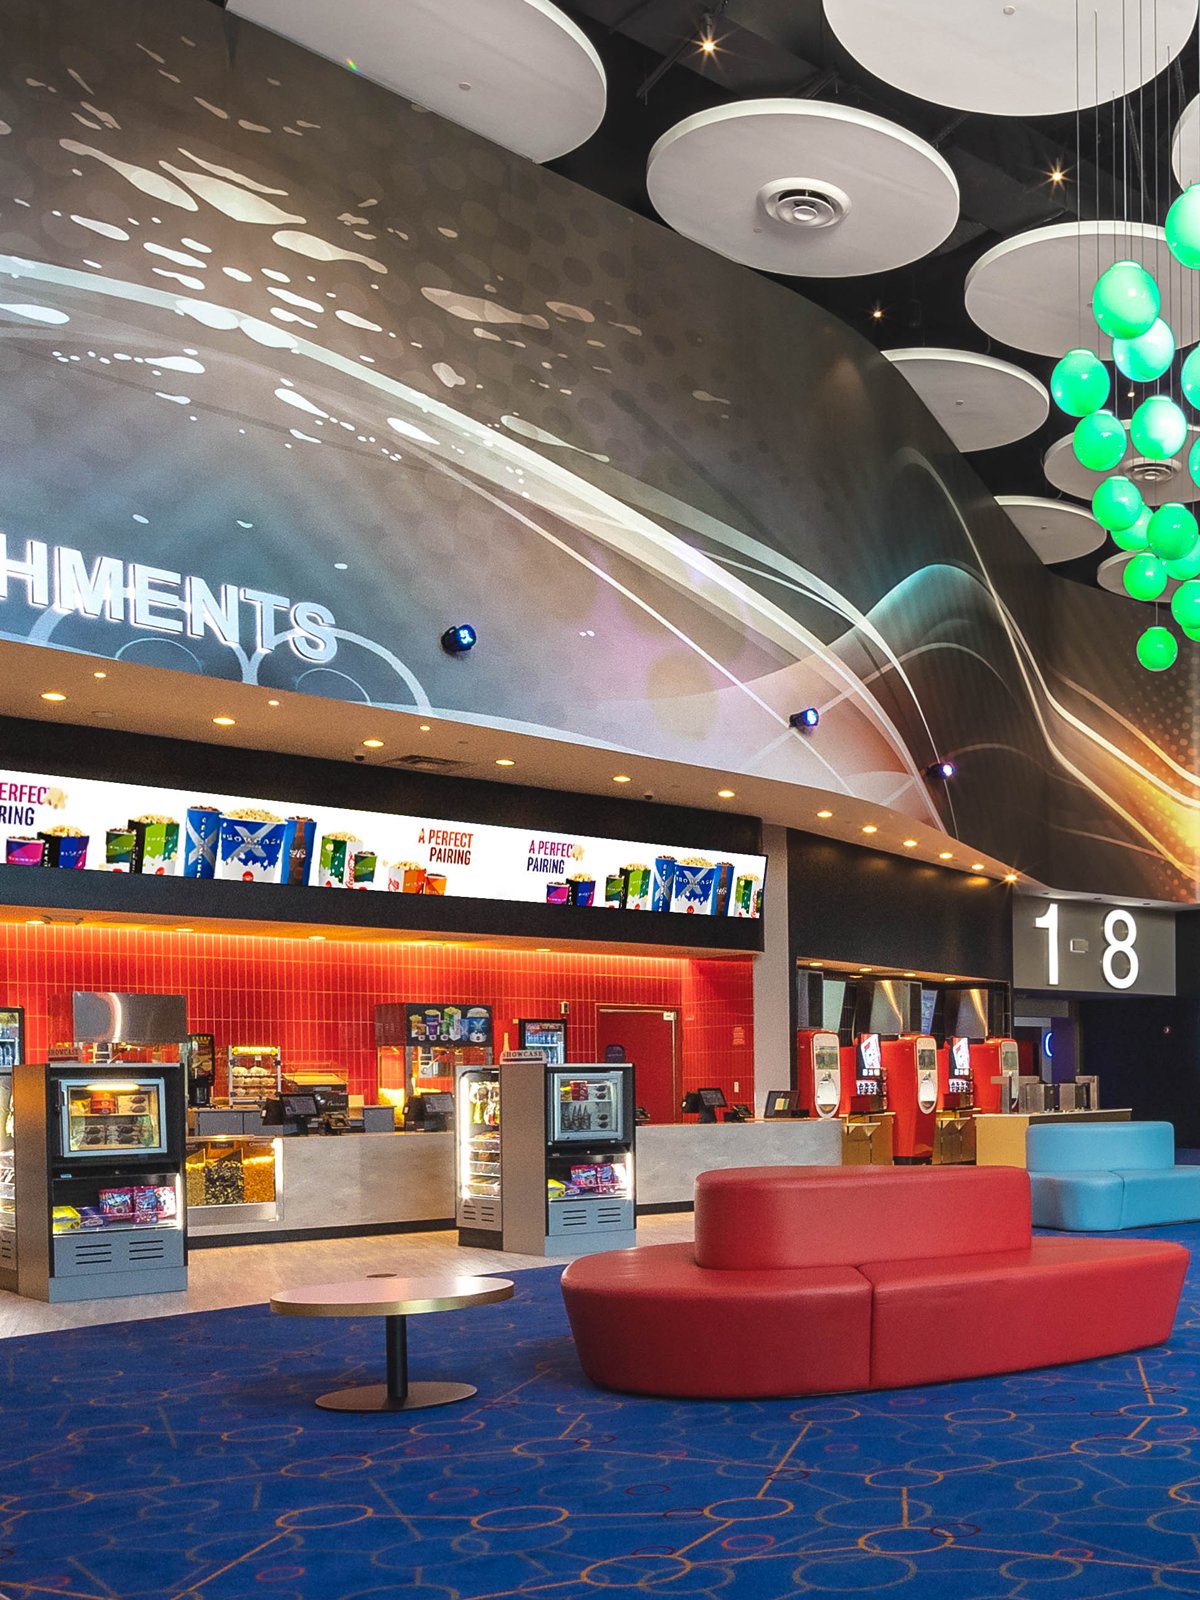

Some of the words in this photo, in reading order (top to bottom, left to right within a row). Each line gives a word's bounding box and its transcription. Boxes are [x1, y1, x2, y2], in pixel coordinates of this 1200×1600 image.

[0, 532, 338, 662] HMENTS
[418, 828, 425, 844] A
[428, 829, 474, 848] PERFECT
[528, 839, 535, 854] A
[429, 847, 471, 865] PAIRING
[527, 856, 565, 875] PAIRING
